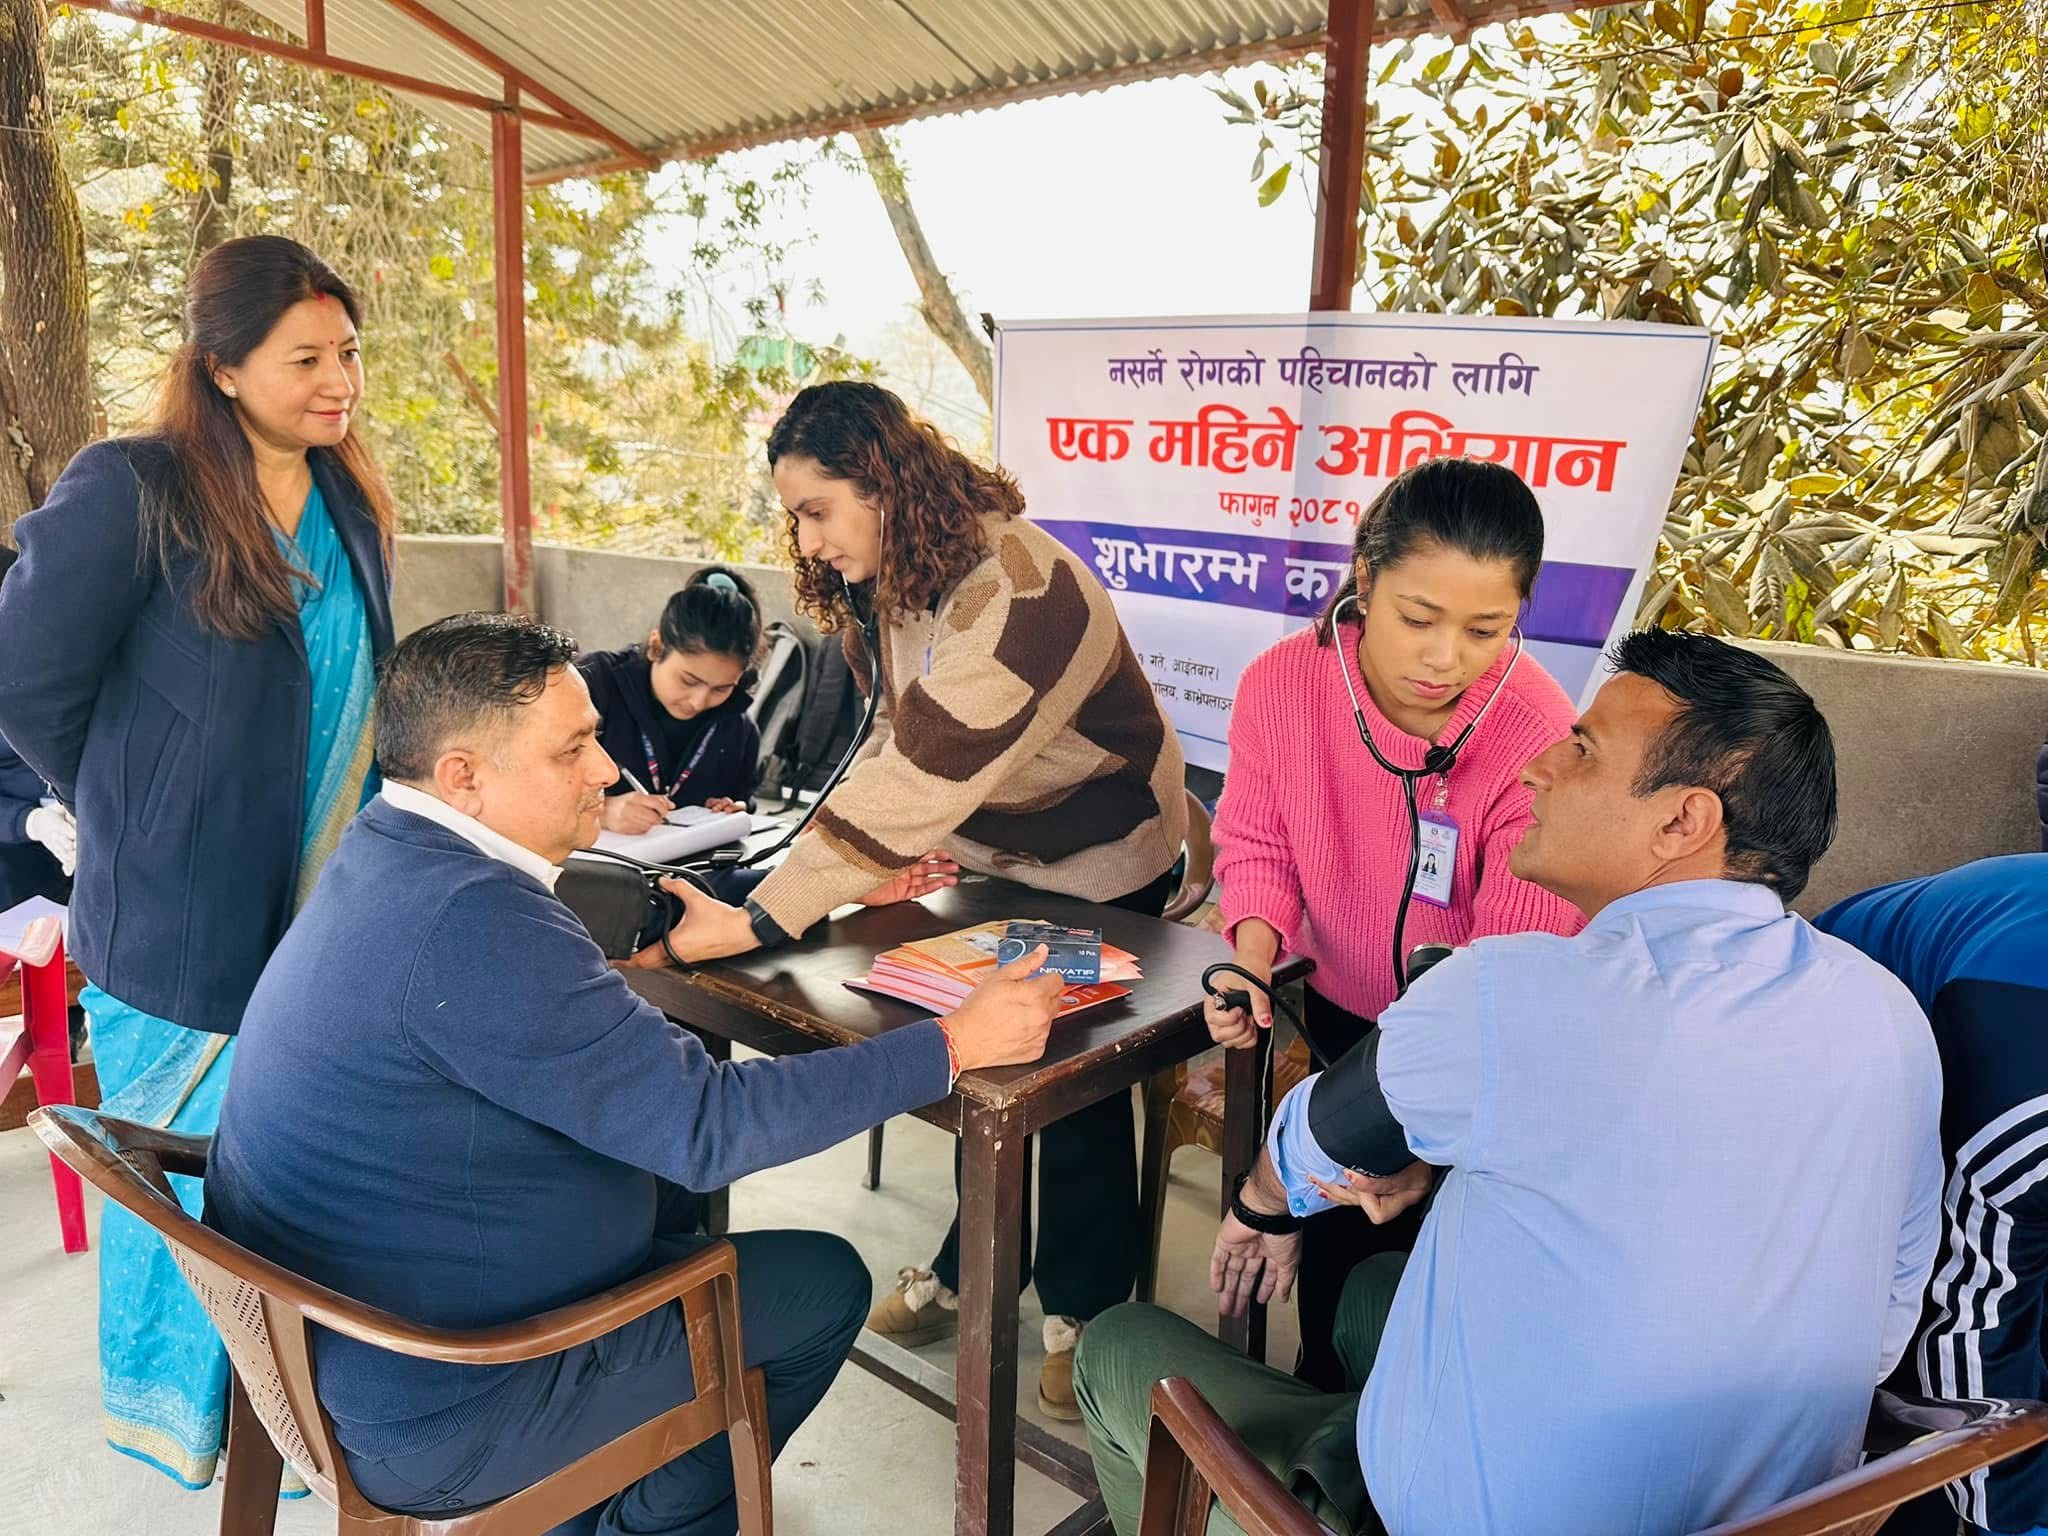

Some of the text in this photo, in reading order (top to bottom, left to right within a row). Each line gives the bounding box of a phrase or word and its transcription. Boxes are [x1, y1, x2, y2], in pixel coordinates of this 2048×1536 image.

[1108, 347, 1540, 396] नसर्ने रोगको पहिचानको लागि
[1046, 417, 1134, 463] एक
[1149, 404, 1303, 474] महिने
[1218, 491, 1361, 528] फागुन २०८१
[1091, 536, 1354, 602] शुभारम्भ का
[1040, 967, 1095, 976] NOVATIP
